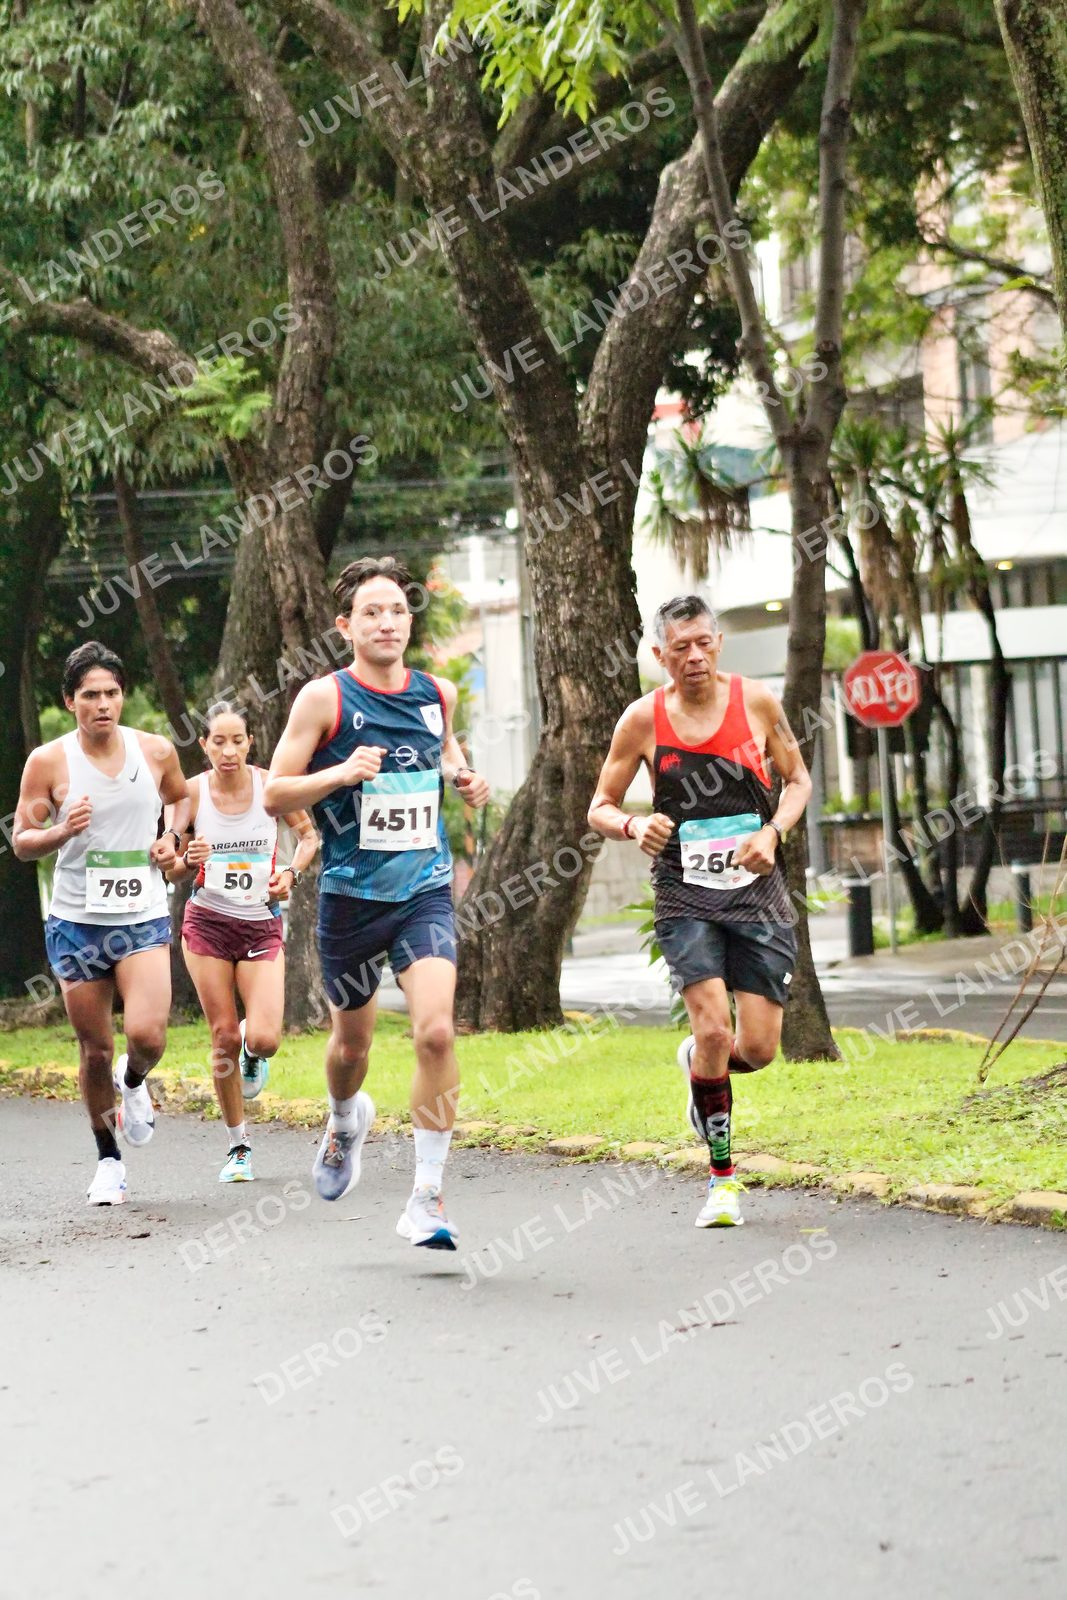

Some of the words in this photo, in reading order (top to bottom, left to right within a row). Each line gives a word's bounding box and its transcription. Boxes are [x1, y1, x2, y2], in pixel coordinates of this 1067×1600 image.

[368, 806, 432, 831] 4511
[211, 838, 269, 850] ARGARITOS
[100, 879, 142, 898] 769
[224, 873, 253, 890] 50
